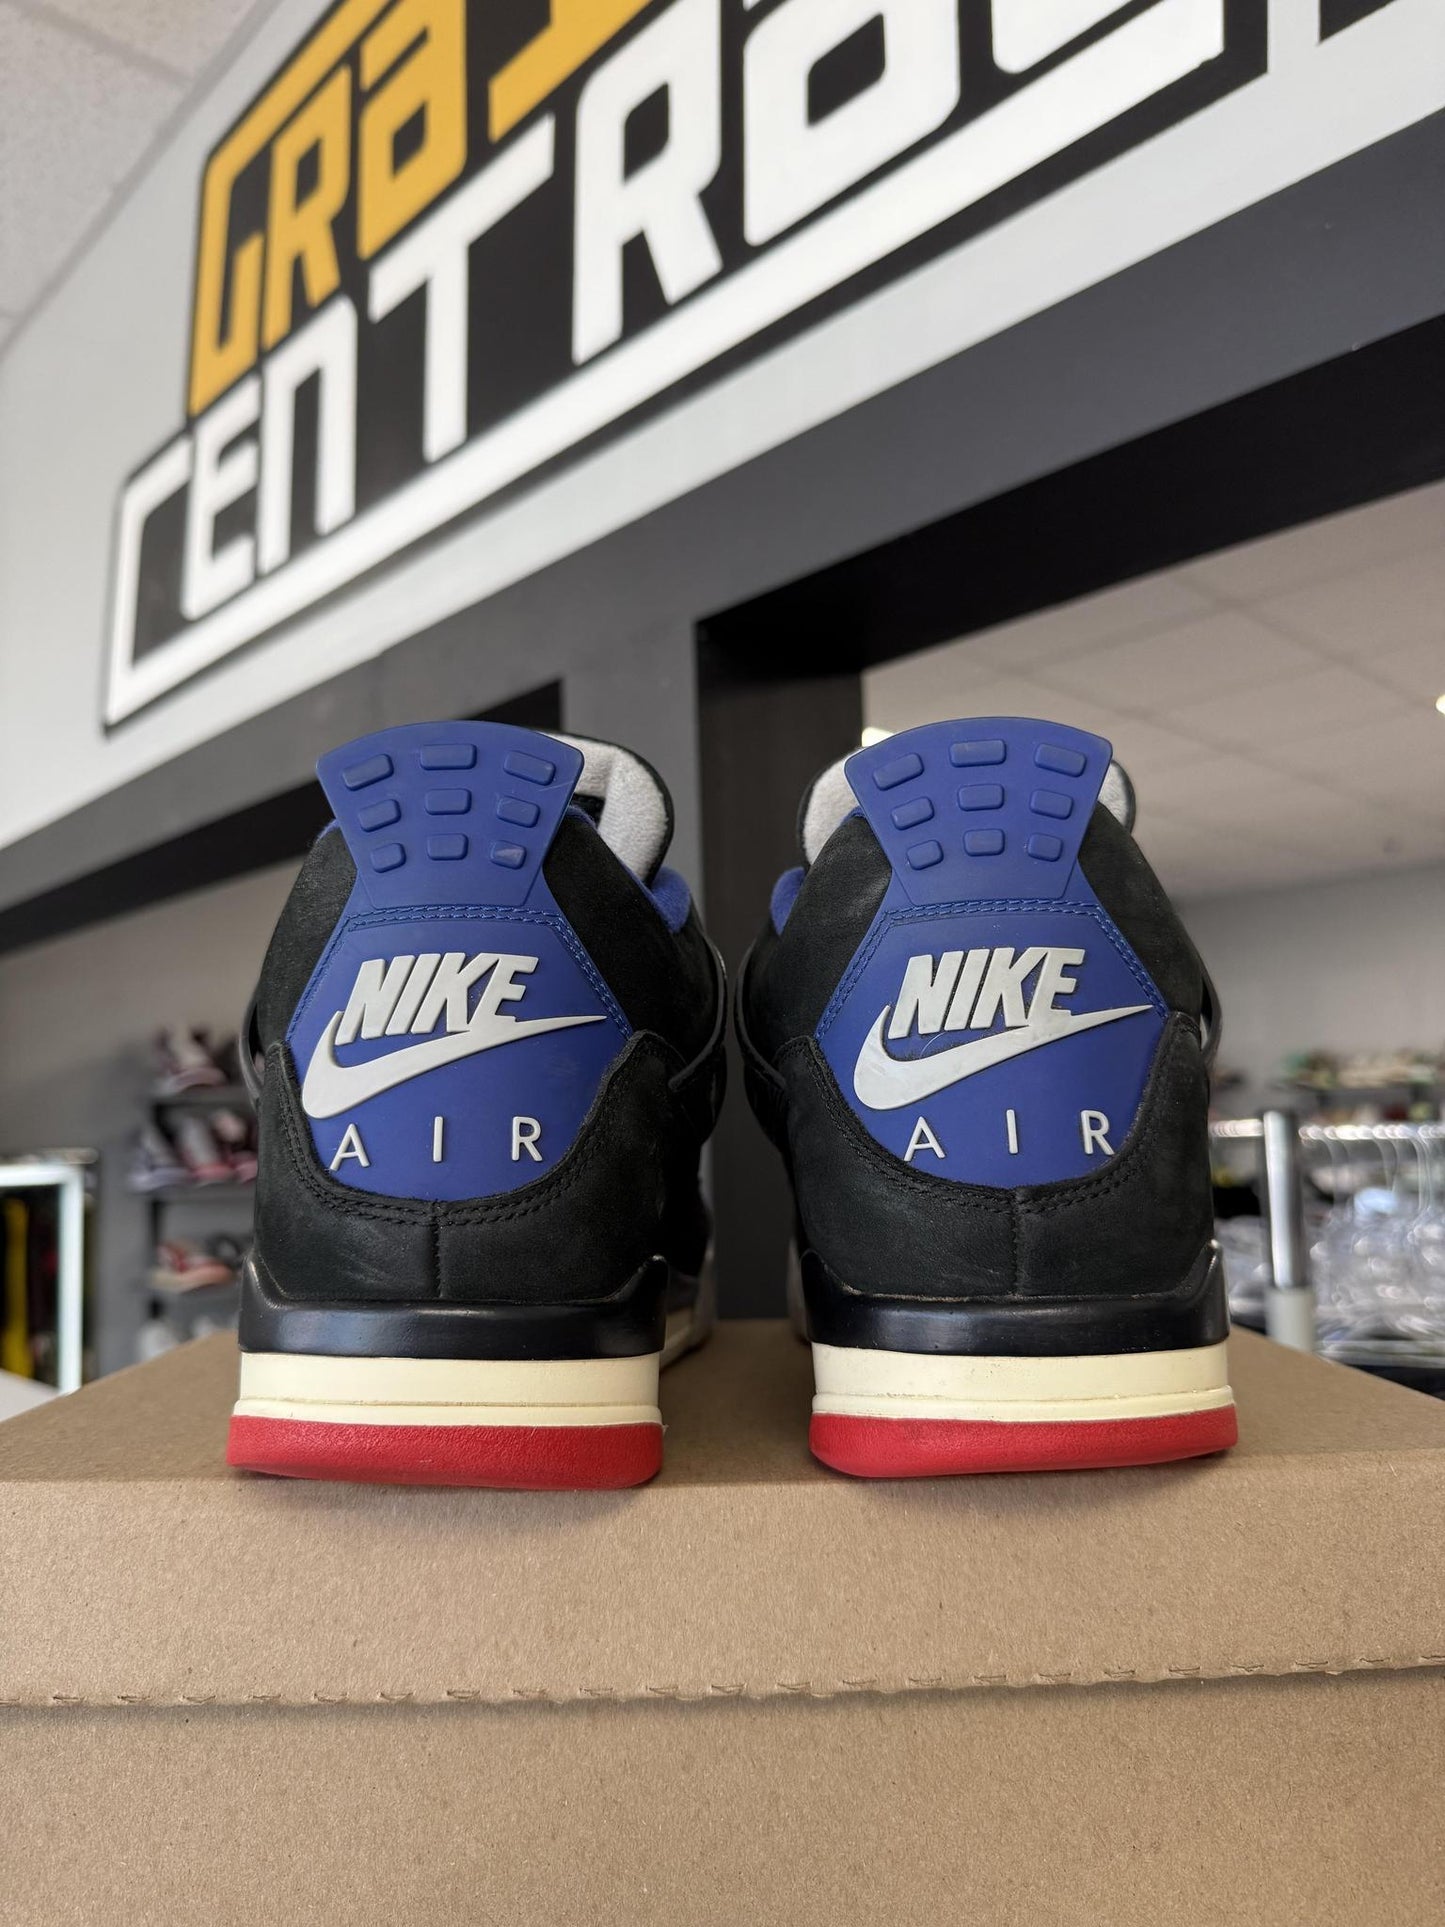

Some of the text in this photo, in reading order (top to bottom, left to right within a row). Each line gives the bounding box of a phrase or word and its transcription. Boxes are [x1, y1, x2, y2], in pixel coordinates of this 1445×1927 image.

[335, 952, 539, 1046] NIKE
[887, 946, 1086, 1040] NIKE
[330, 1115, 543, 1172] AIR
[904, 1108, 1115, 1162] AIR
